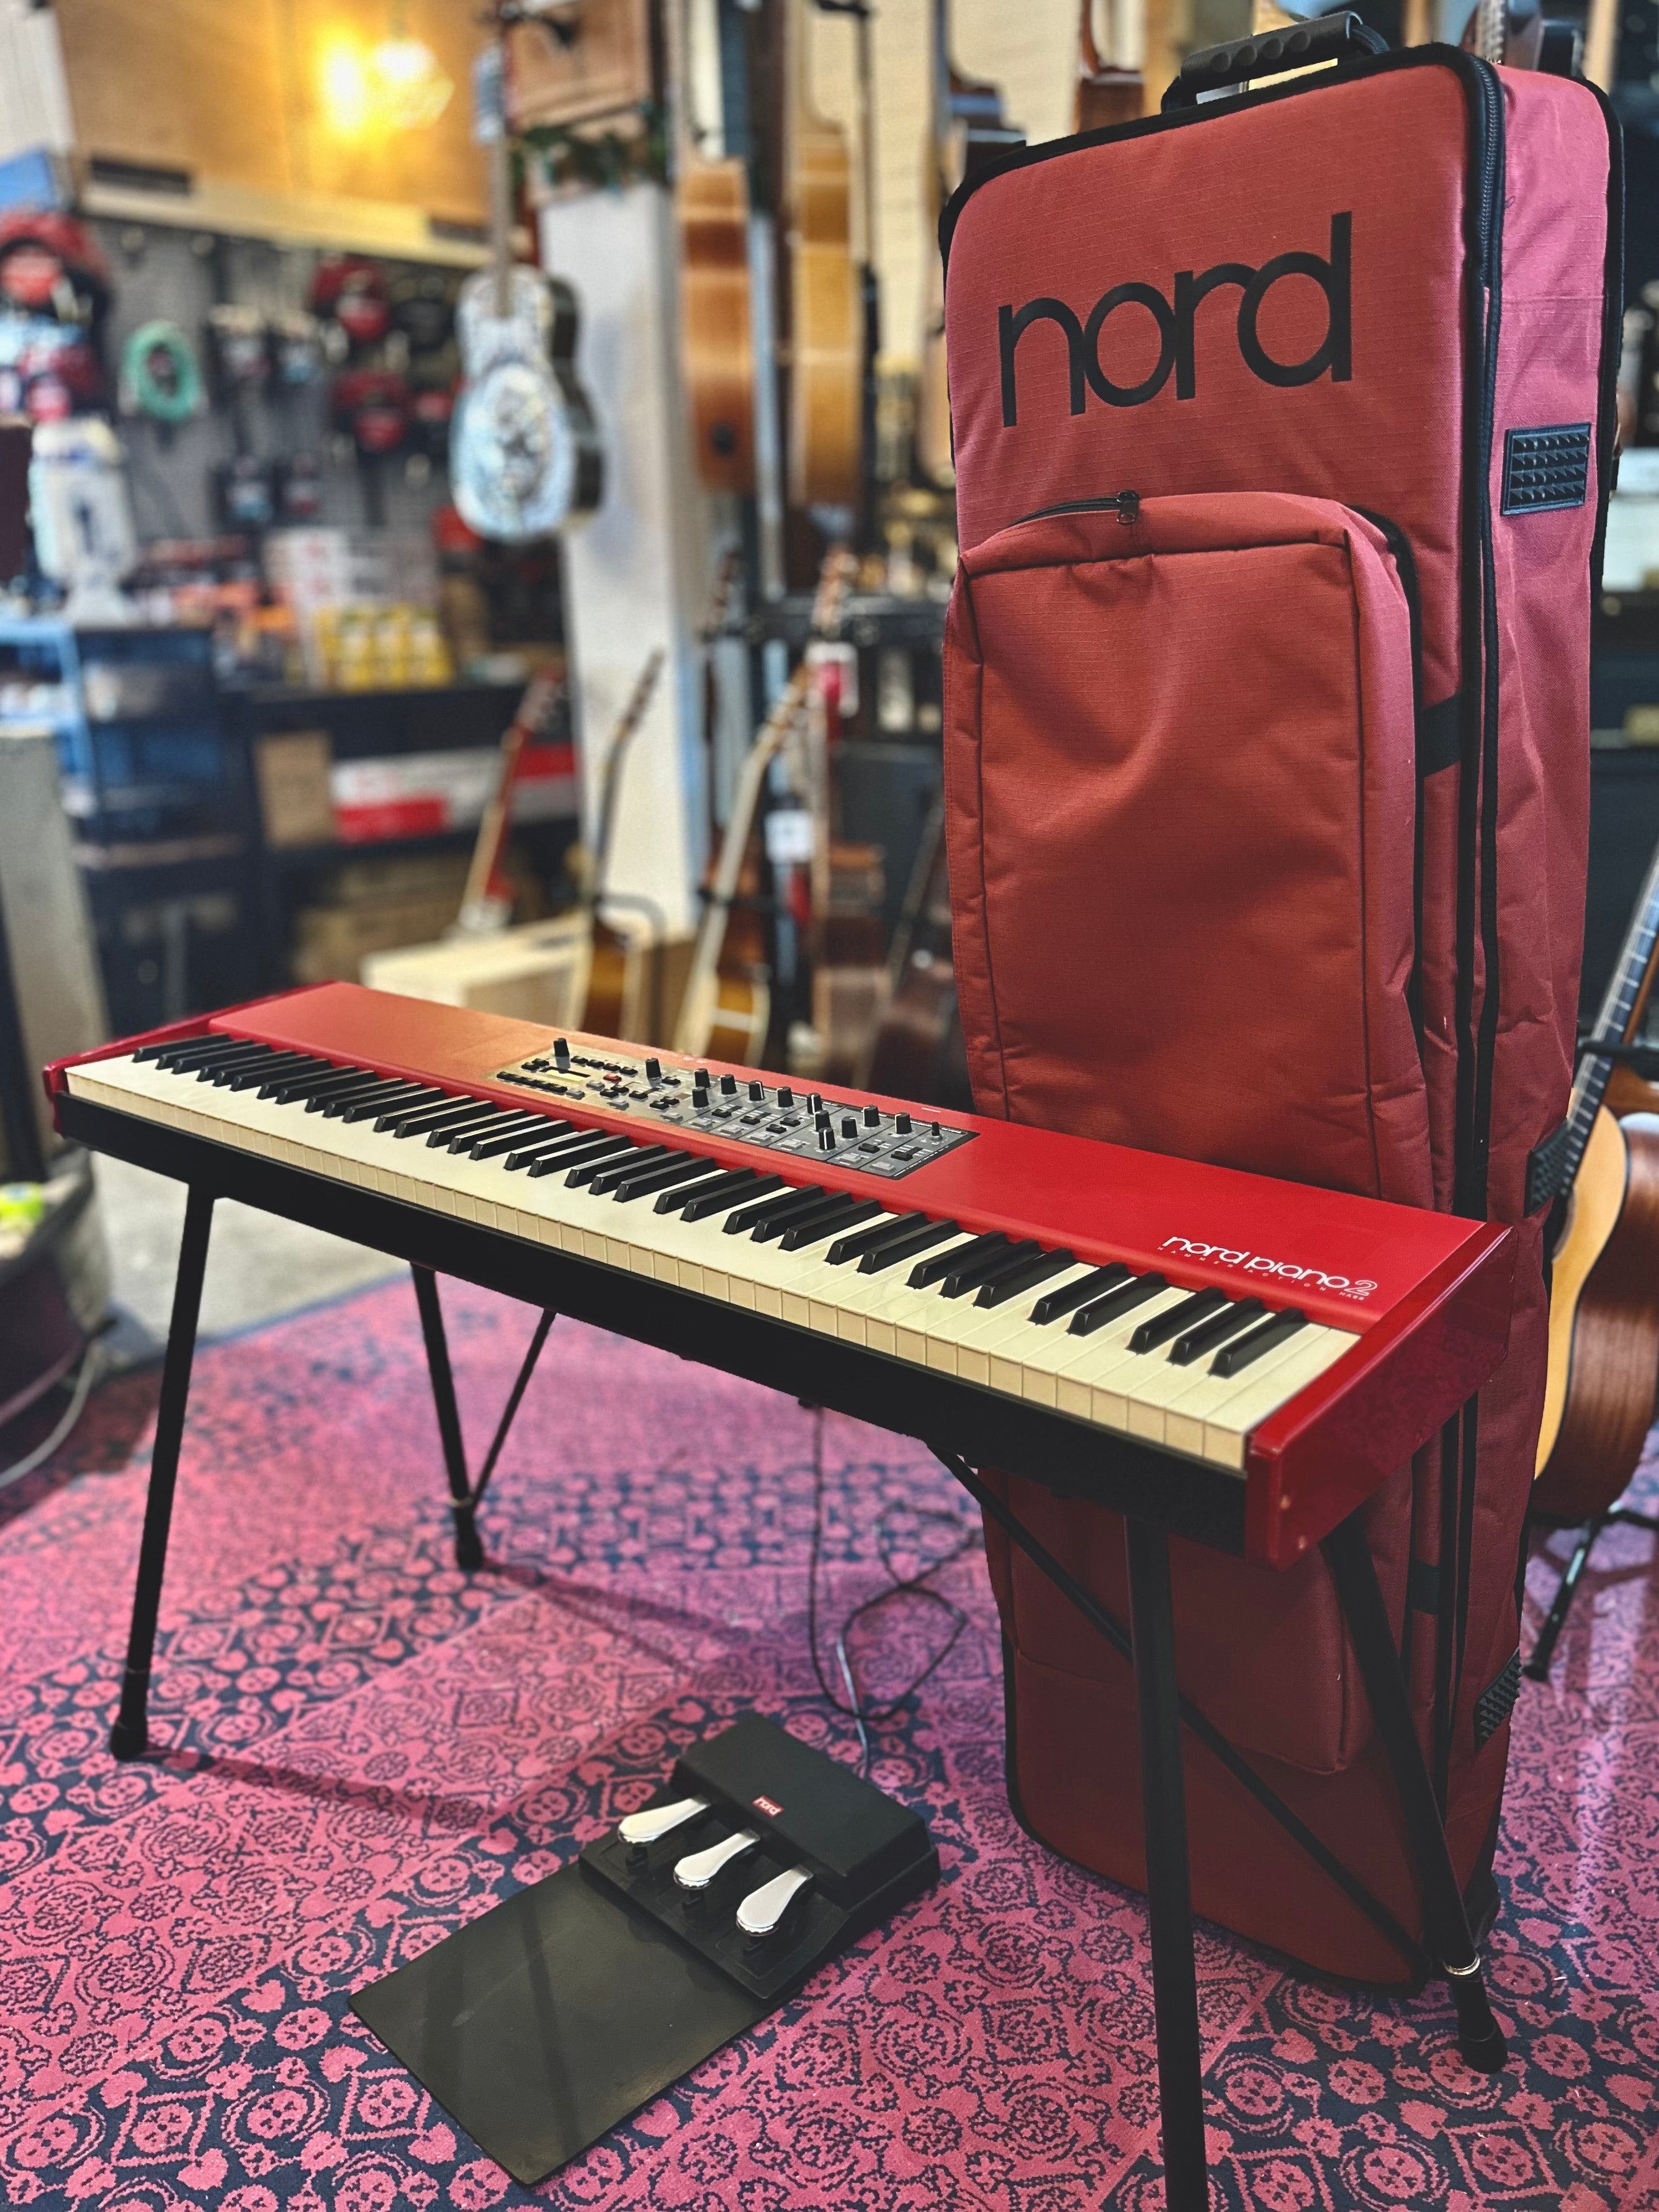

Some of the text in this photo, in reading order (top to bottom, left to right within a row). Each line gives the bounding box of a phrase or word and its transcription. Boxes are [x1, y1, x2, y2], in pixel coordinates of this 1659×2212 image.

[998, 211, 1352, 428] nord
[1162, 1236, 1250, 1264] nord
[1157, 1246, 1326, 1292] HAMMER ACTION
[752, 1797, 781, 1815] nord
